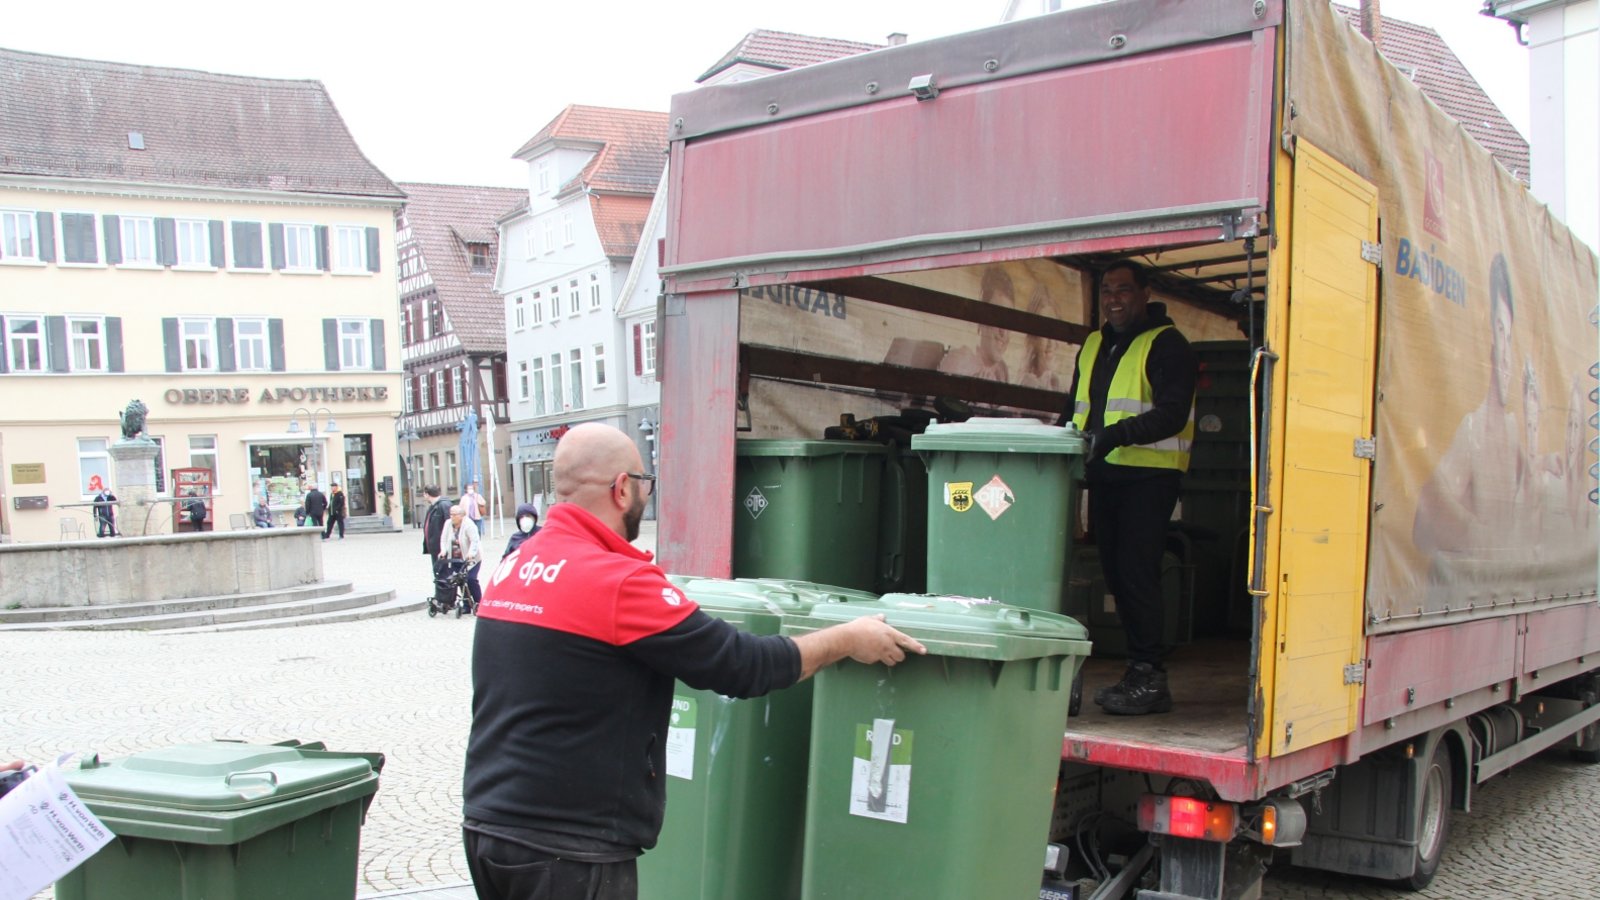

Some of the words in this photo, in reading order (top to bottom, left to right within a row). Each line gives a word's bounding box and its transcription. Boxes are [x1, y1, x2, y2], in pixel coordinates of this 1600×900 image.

[164, 388, 249, 405] OBERE
[258, 387, 388, 404] APOTHEKE
[519, 555, 567, 587] dpd
[866, 729, 902, 746] RD
